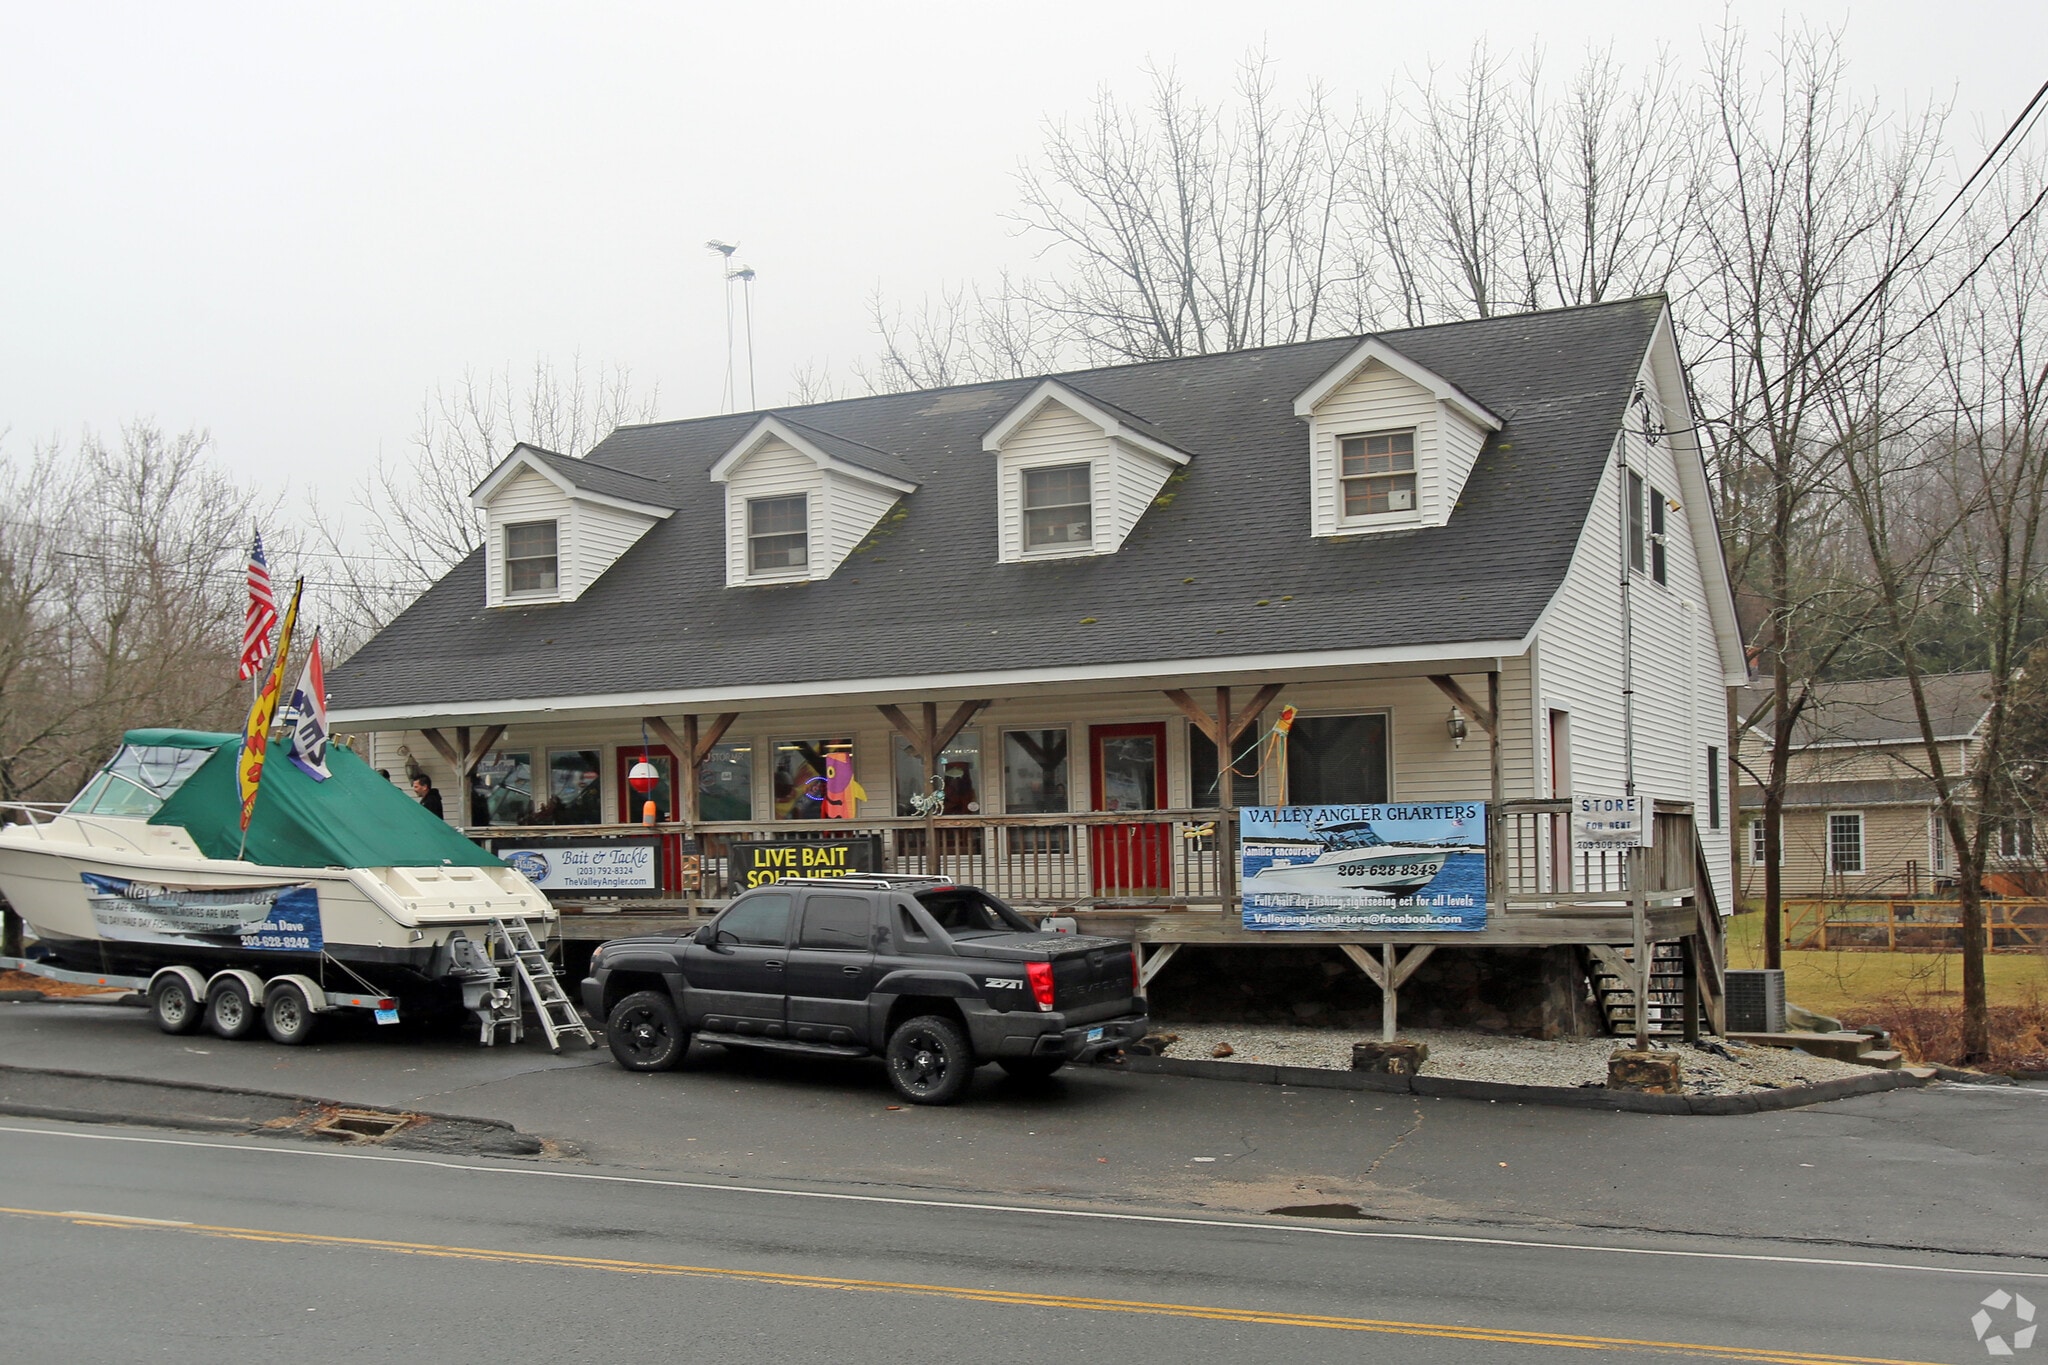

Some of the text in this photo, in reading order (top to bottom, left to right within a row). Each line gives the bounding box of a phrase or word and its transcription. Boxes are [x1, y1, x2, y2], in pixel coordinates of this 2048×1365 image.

[1582, 798, 1636, 812] STORE
[1249, 805, 1477, 823] VALLEY ANGLER CHARTERS
[1586, 821, 1632, 830] FOR RENT
[562, 850, 588, 865] Bait
[609, 847, 648, 868] Tackle
[754, 847, 848, 868] LIVE BAIT
[1275, 845, 1321, 858] encouraged
[576, 866, 633, 875] (203) 792-8324
[1337, 863, 1439, 877] 203-628-8242
[565, 877, 647, 888] TheValleyAngler.com
[1415, 895, 1430, 906] for
[1432, 894, 1444, 906] all
[1447, 894, 1474, 907] levels
[206, 909, 219, 919] ARE
[220, 909, 240, 920] MADE
[1254, 913, 1462, 925] Valleyanglercharters@facebook.com
[279, 920, 304, 932] Dave
[240, 935, 310, 948] 203-628-8242
